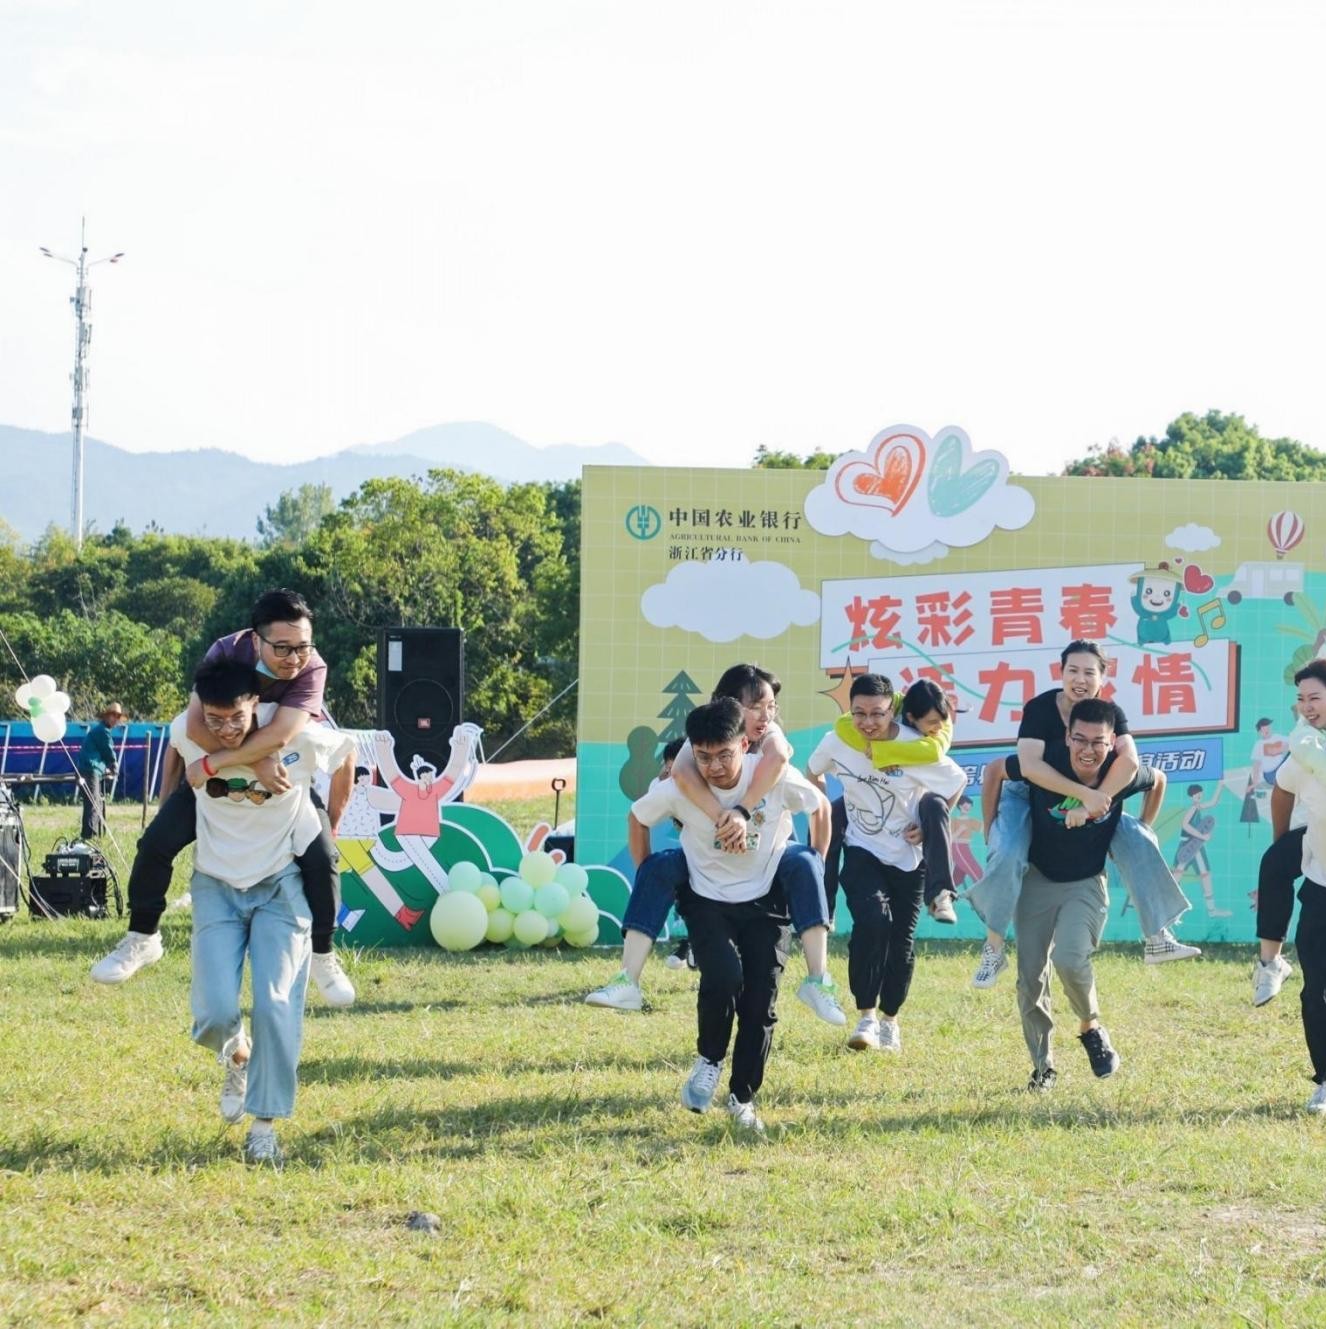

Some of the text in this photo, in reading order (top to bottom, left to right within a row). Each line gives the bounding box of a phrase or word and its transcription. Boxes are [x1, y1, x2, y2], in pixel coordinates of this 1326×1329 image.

[669, 507, 802, 530] 中国农业银行
[670, 533, 732, 542] AGRICULTURAL
[736, 534, 759, 543] BANK
[775, 536, 801, 544] CHINA
[669, 545, 743, 561] 浙江省分行
[844, 583, 1117, 652] 炫彩青春
